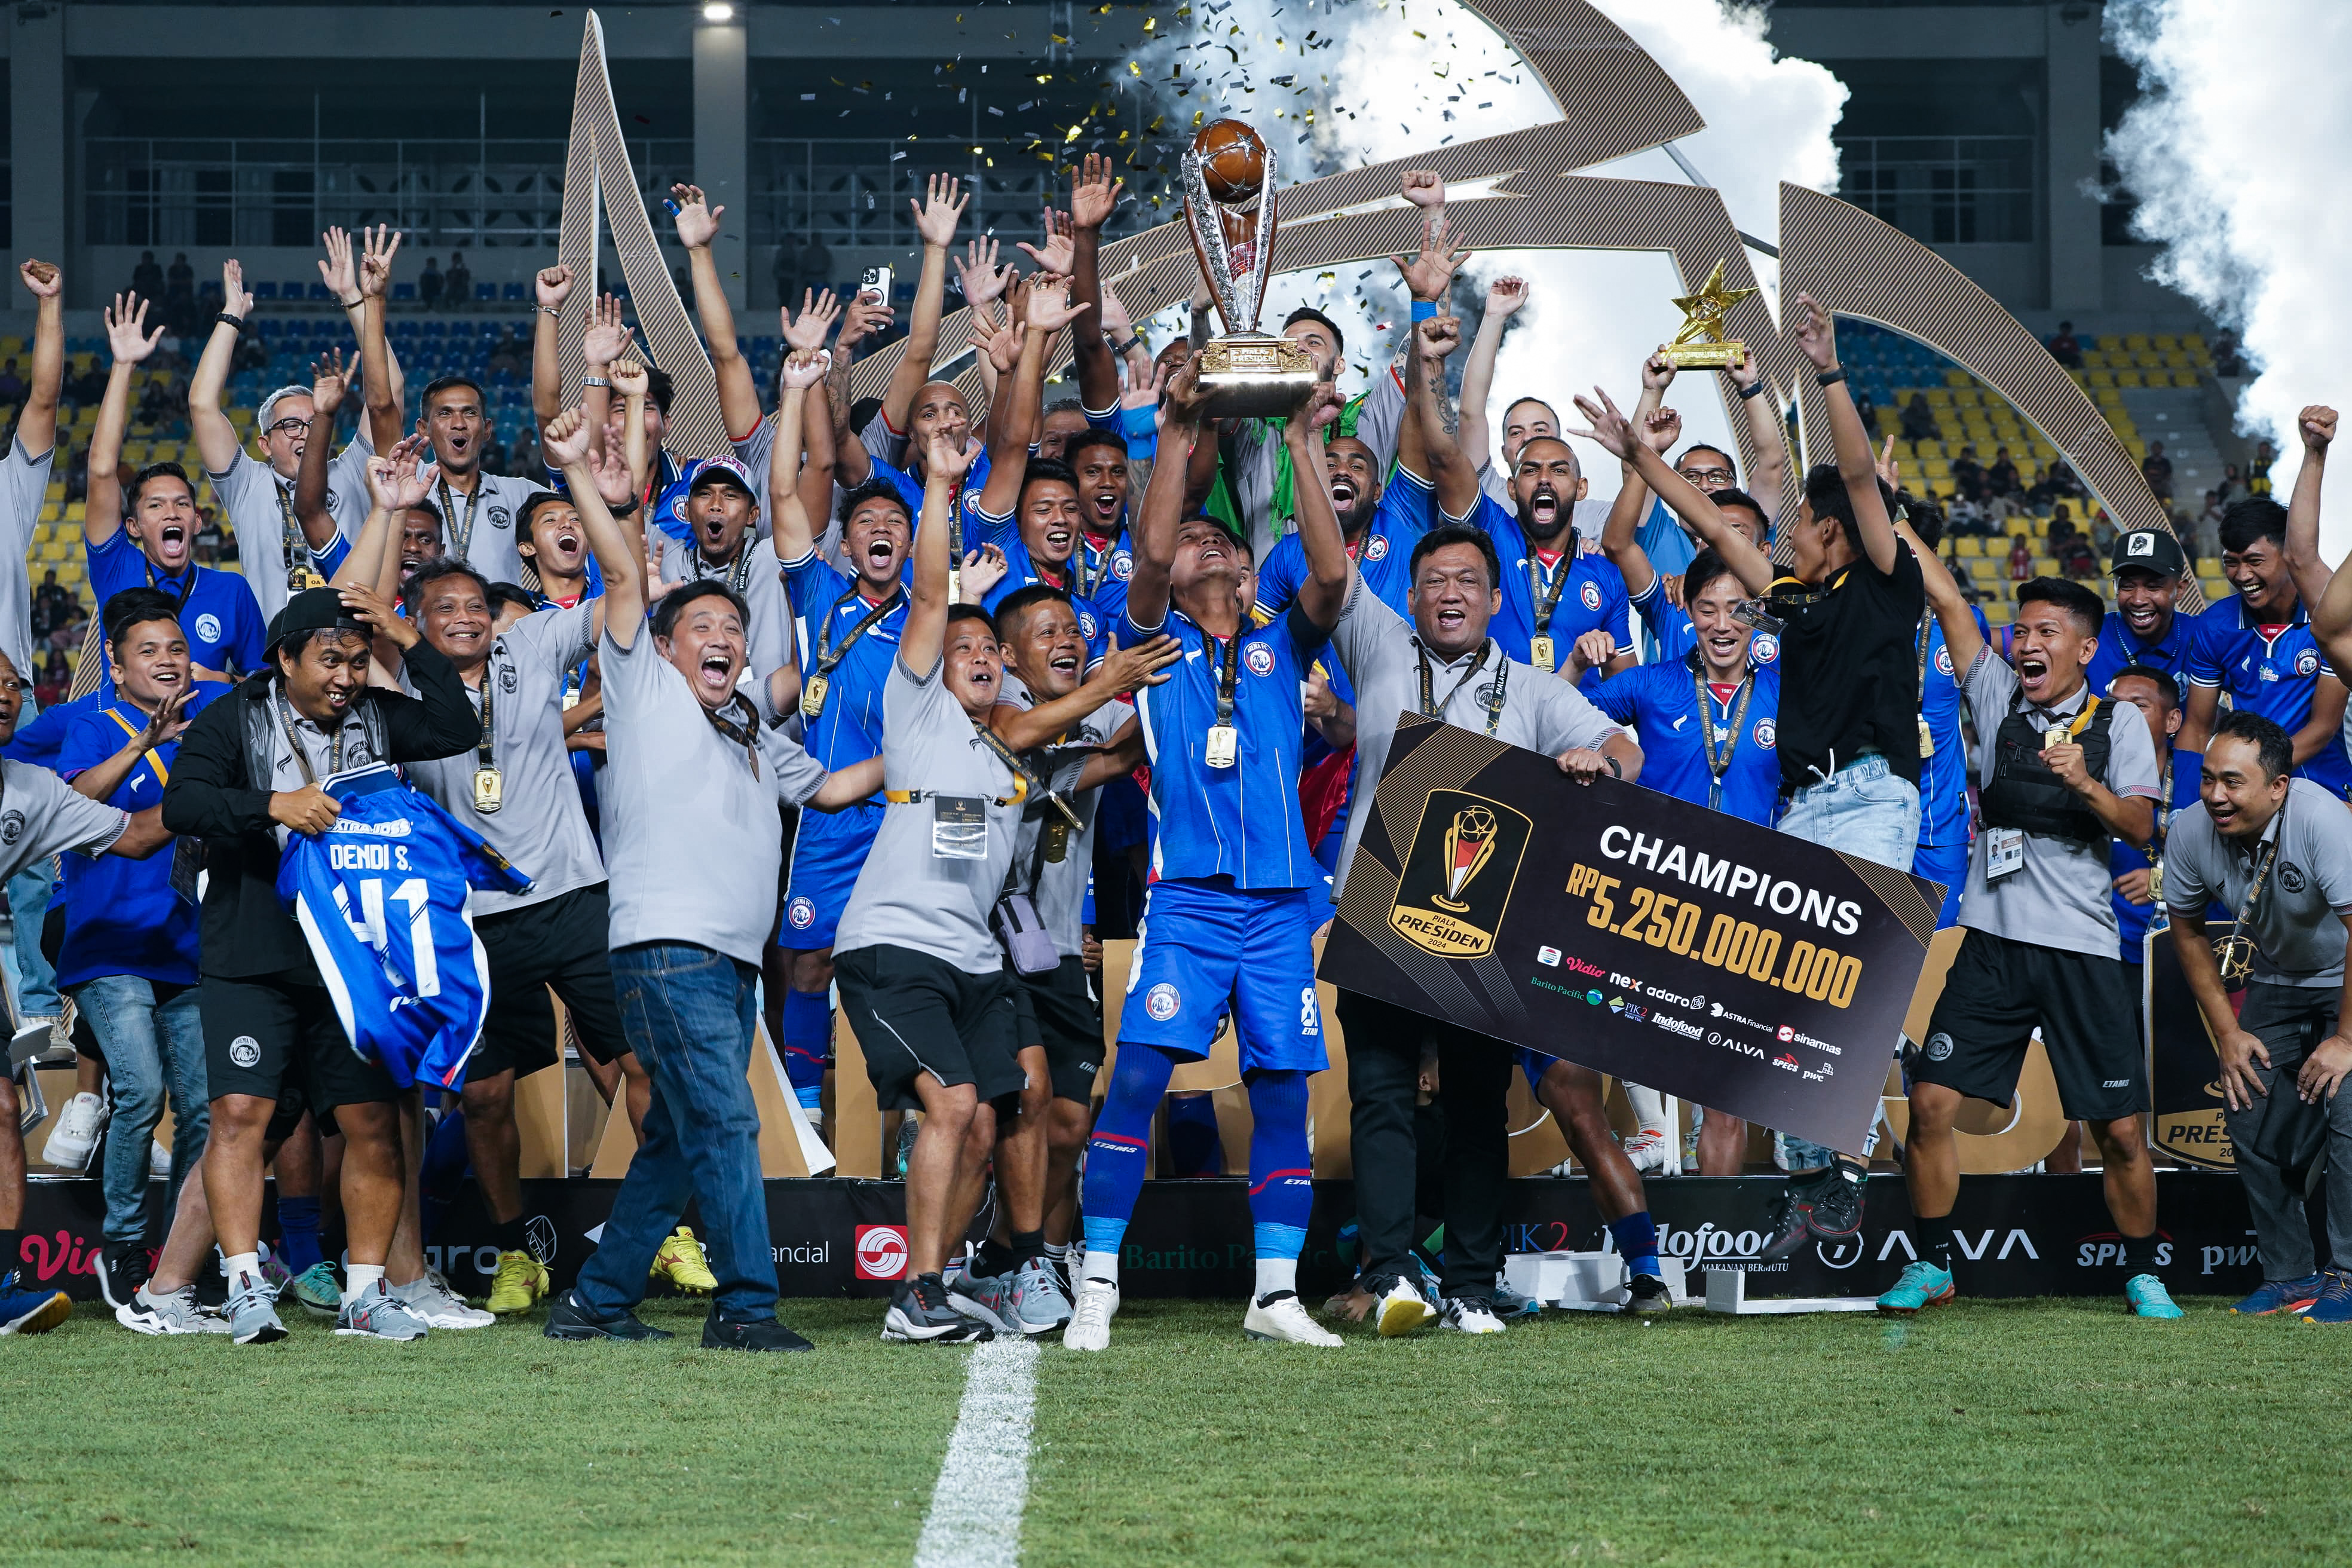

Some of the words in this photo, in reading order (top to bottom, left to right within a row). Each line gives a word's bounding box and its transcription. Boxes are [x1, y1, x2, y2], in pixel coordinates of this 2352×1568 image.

[1532, 559, 1540, 587] PRESIDEN
[853, 622, 866, 634] PIALA
[866, 605, 886, 624] PRESIDEN
[1922, 618, 1930, 648] PRESIDEN
[1247, 643, 1261, 654] AREMA
[2299, 650, 2311, 659] AREMA
[1496, 676, 1505, 695] PIALA
[1702, 706, 1711, 734] PRESIDEN
[1734, 713, 1743, 730] PIALA
[1740, 688, 1750, 714] PRESIDEN
[330, 844, 390, 870] DENDI
[394, 845, 413, 871] S.
[1600, 825, 1862, 936] CHAMPIONS
[2258, 865, 2269, 883] PIALA
[806, 899, 811, 908] FC
[1432, 914, 1457, 927] PIALA
[332, 878, 442, 998] 41
[1397, 914, 1485, 950] PRESIDEN
[1427, 938, 1447, 949] 2024
[1566, 957, 1606, 977] Vidio
[1154, 985, 1171, 994] AREMA
[1170, 989, 1177, 997] FC
[1530, 976, 1557, 991] Barito
[1557, 986, 1585, 1000] Pacific
[1609, 972, 1643, 992] nex
[1646, 987, 1690, 1007] adaro
[1625, 1002, 1641, 1015] PIK
[1640, 1007, 1647, 1017] 2
[1652, 1012, 1704, 1037] Indofood
[1723, 1010, 1747, 1025] ASTRA
[1747, 1018, 1774, 1033] Financial
[1722, 1038, 1765, 1060] ALVA
[1793, 1033, 1842, 1056] sinarmas
[1772, 1058, 1799, 1073] SPECS
[1802, 1070, 1824, 1082] pwc
[2102, 1079, 2130, 1088] ETAMS
[1094, 1141, 1138, 1153] ETAMS
[1550, 1221, 1569, 1251] 2
[1877, 1229, 2040, 1261] AVA
[771, 1241, 829, 1263] ancial
[1125, 1244, 1216, 1269] Barito
[1227, 1244, 1328, 1269] Paic
[1748, 1263, 1789, 1272] BERMUTU
